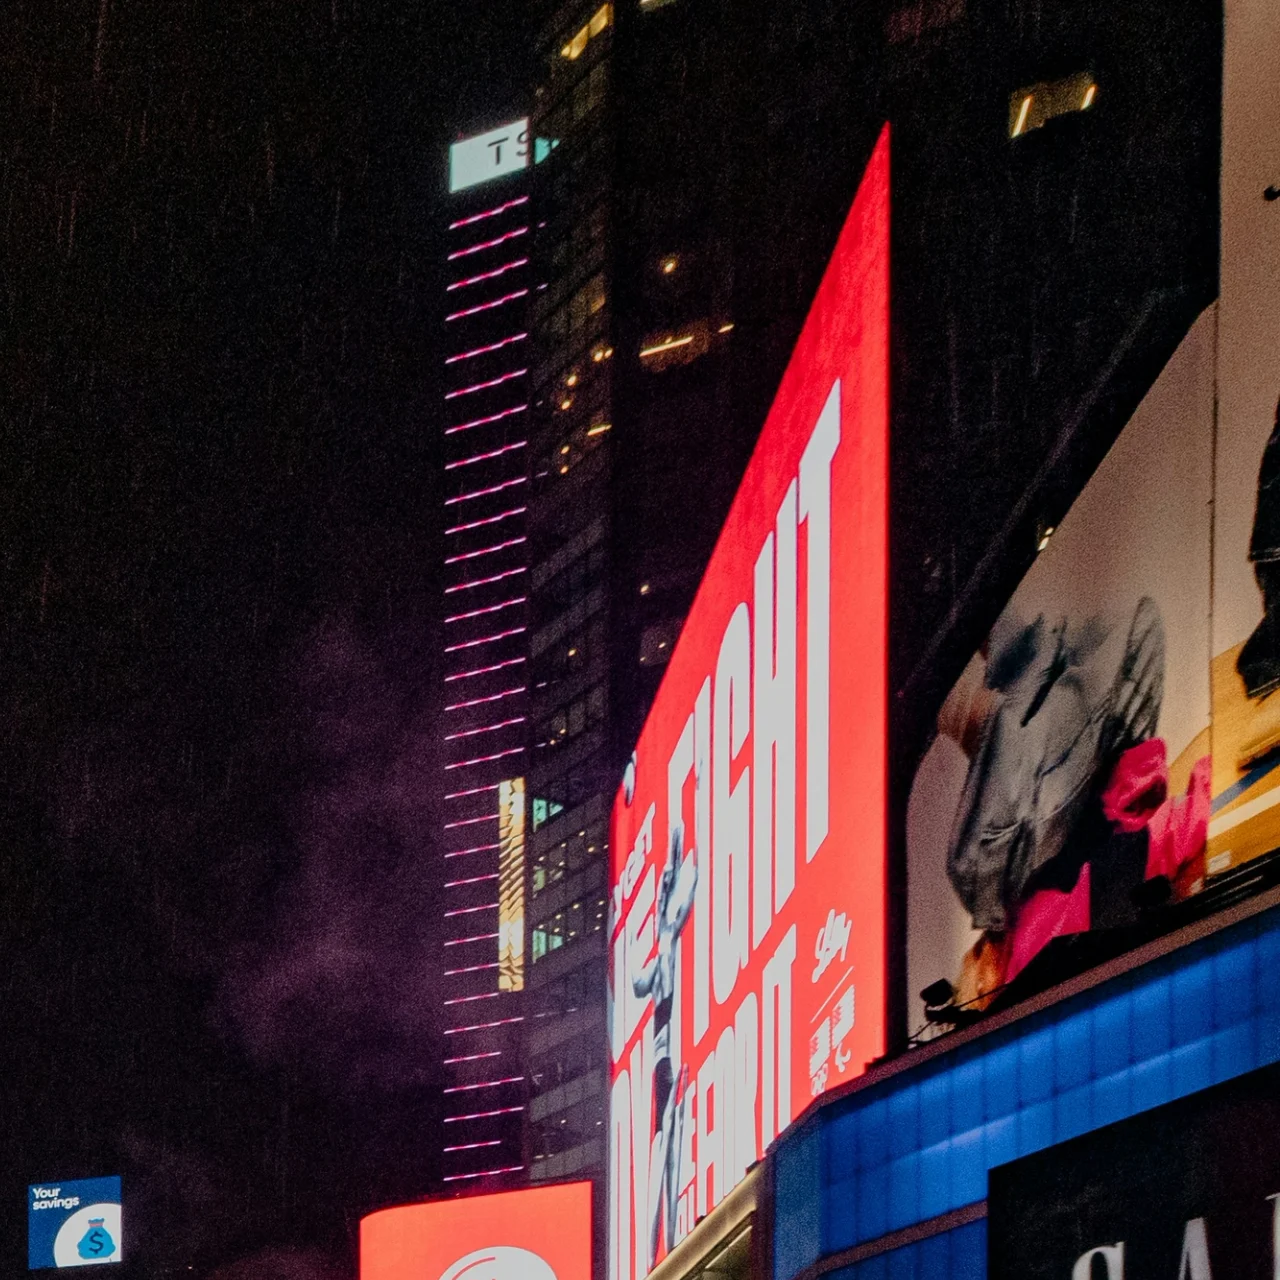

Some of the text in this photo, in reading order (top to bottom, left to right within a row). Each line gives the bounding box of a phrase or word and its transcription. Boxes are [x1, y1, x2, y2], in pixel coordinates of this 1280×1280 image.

[668, 378, 841, 1047] FIGHT
[32, 1187, 61, 1199] Your
[32, 1196, 80, 1210] savings
